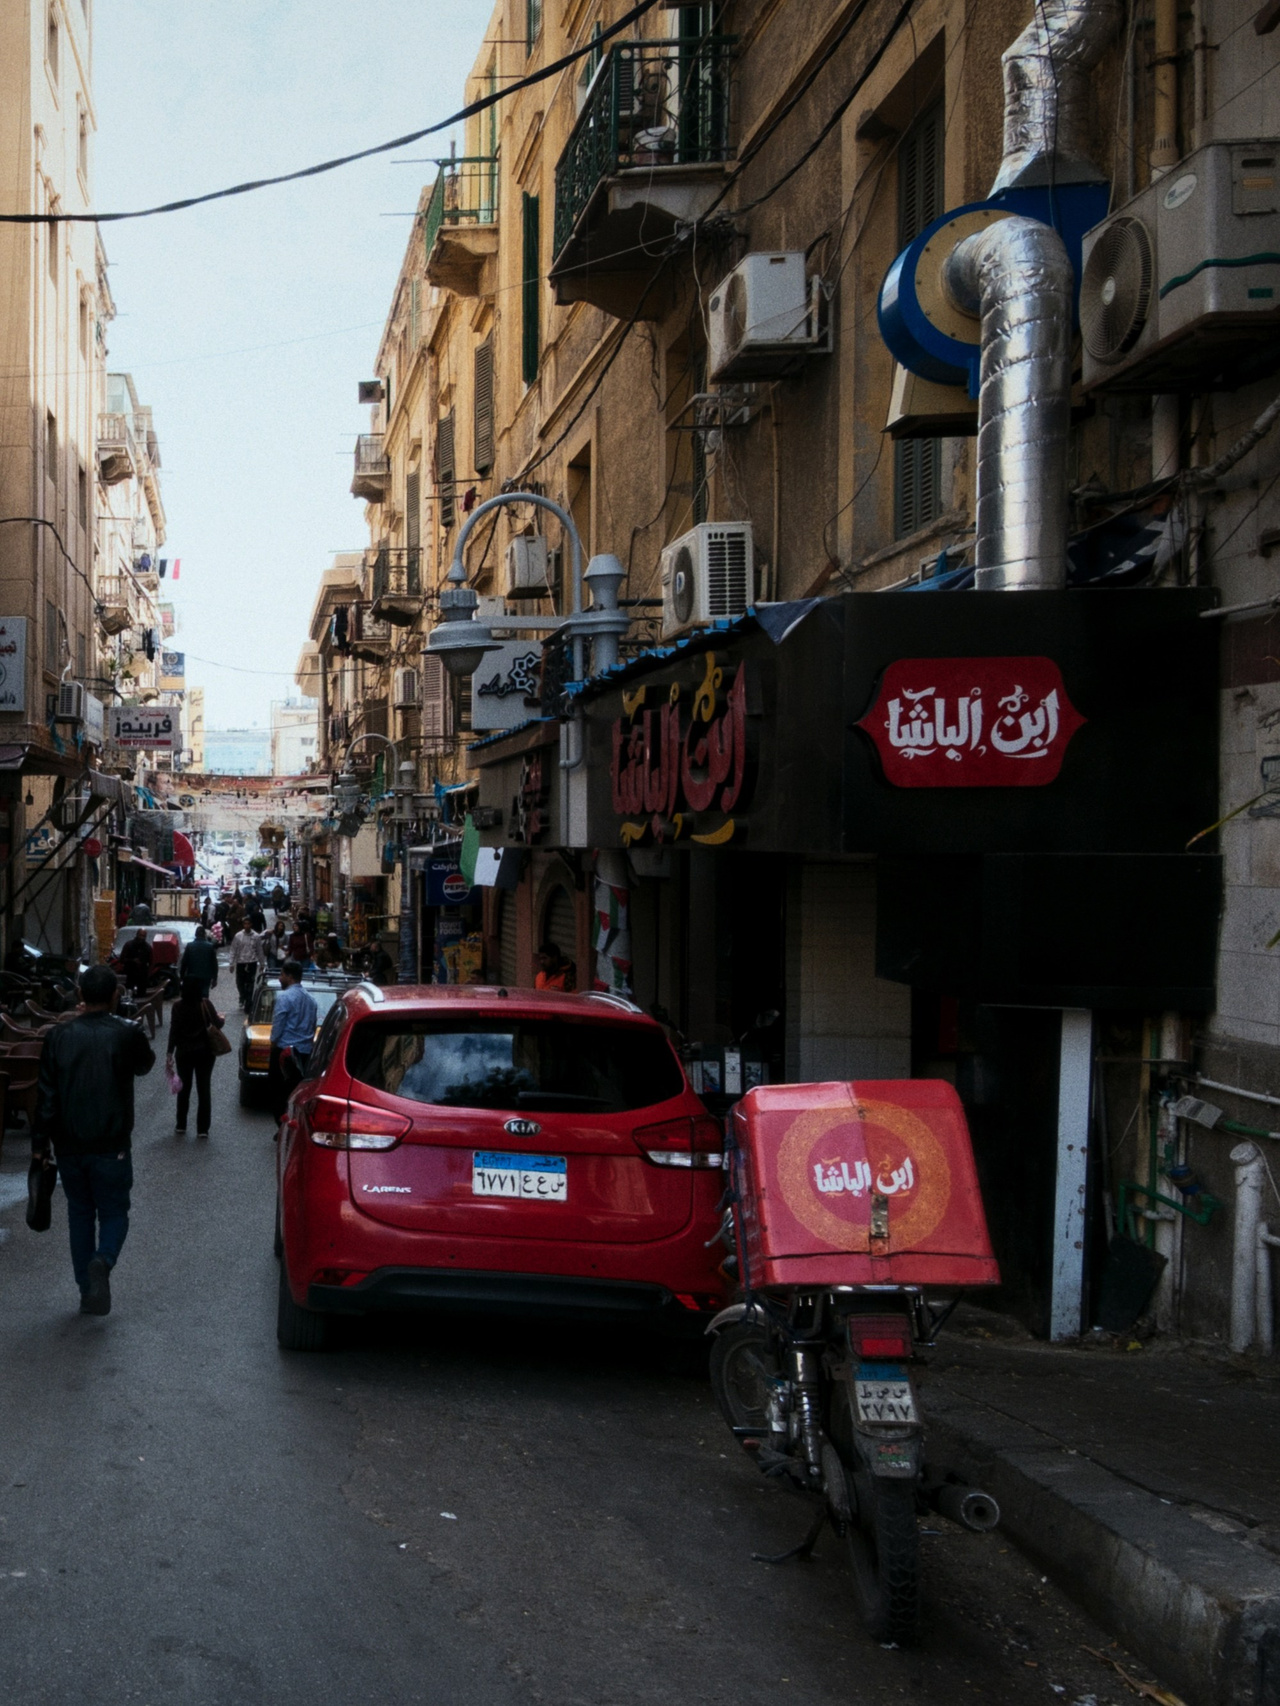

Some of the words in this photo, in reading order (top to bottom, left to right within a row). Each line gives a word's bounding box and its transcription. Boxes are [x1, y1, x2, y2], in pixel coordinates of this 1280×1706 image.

[114, 714, 172, 738] فريندز
[681, 655, 746, 814] ابن
[885, 688, 984, 761] الباشا
[991, 686, 1060, 757] ابن
[510, 1122, 536, 1133] KIA
[477, 1171, 516, 1192] ٦٧٧١
[813, 1158, 872, 1197] الباشا
[877, 1156, 915, 1195] ابن
[861, 1403, 910, 1421] ٣٧٩٧
